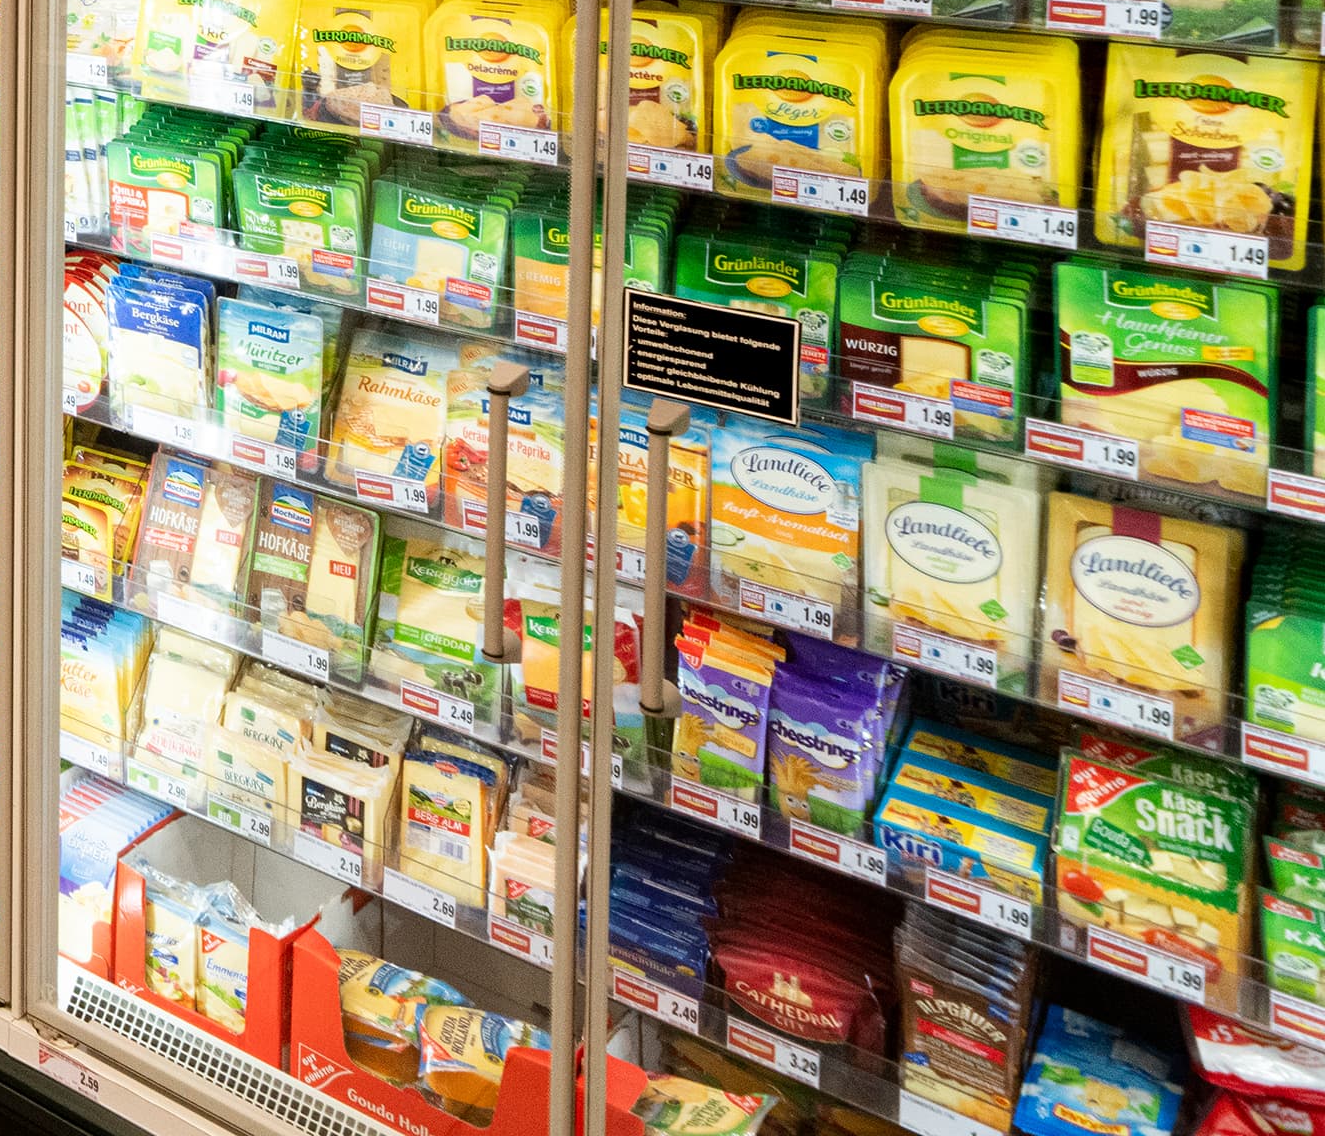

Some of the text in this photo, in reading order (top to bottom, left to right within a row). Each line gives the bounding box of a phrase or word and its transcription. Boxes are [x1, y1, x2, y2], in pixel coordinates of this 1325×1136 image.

[1125, 8, 1158, 26] 1.99
[313, 30, 397, 53] LEERDAMMER
[446, 37, 543, 64] LEERDAMMER
[467, 64, 517, 77] Delacrème
[734, 74, 855, 107] LEERDAMMER
[1135, 79, 1290, 118] LEERDAMMER
[914, 99, 1049, 130] LEERDAMMER
[945, 126, 1013, 145] Original
[533, 141, 555, 155] 1.49
[686, 164, 712, 180] 1.49
[838, 187, 866, 205] 1.49
[405, 198, 476, 224] Grünländer
[1043, 217, 1075, 236] 1.49
[1230, 245, 1264, 264] 1.49
[279, 265, 297, 277] 1.99
[714, 253, 799, 279] Grünländer
[1113, 280, 1208, 302] Grünländer
[417, 298, 438, 313] 1.99
[633, 302, 686, 319] Information:
[880, 291, 976, 318] Grünländer
[132, 308, 179, 328] Bergkäse
[251, 324, 287, 341] MILRAM
[632, 324, 668, 337] Vorteile:
[633, 315, 781, 351] Diese Verglasung bietet folgende
[237, 339, 303, 366] Müritzer
[638, 339, 714, 359] umweltschonend
[846, 338, 898, 357] WÜRZIG
[1122, 333, 1196, 357] Genuss
[637, 350, 706, 369] energiesparend
[637, 361, 780, 399] immer gleichbleibende Kühlung
[637, 373, 770, 407] optimale Lebensmittelqualität
[359, 375, 441, 407] Rahmkäse
[922, 407, 951, 426] 1.99
[276, 454, 294, 470] 1.99
[1102, 446, 1136, 466] 1.99
[742, 453, 831, 493] Landliebe
[165, 483, 201, 499] Hochland
[405, 488, 425, 503] 1.99
[750, 477, 819, 503] Landkäse
[150, 506, 198, 535] HOFKÄSE
[273, 506, 311, 527] Hochland
[516, 520, 538, 537] 1.99
[894, 516, 996, 558] Landliebe
[259, 531, 311, 563] HOFKÄSE
[333, 562, 351, 576] NEU
[1080, 552, 1194, 599] Landliebe
[804, 607, 831, 627] 1.99
[425, 633, 471, 654] CHEDDAR
[308, 654, 327, 671] 1.99
[963, 654, 994, 675] 1.99
[451, 705, 472, 723] 2.49
[1138, 704, 1171, 726] 1.99
[414, 809, 462, 832] BERG ALM
[732, 808, 758, 829] 1.99
[1136, 799, 1235, 853] Snack
[880, 828, 942, 863] Kiri
[856, 853, 883, 875] 1.99
[433, 898, 454, 917] 2.69
[997, 904, 1029, 928] 1.99
[1168, 965, 1202, 991] 1.99
[671, 1002, 698, 1024] 2.49
[735, 980, 843, 1029] CATHEDRAL
[790, 1052, 818, 1076] 3.29
[347, 1088, 395, 1124] Gouda
